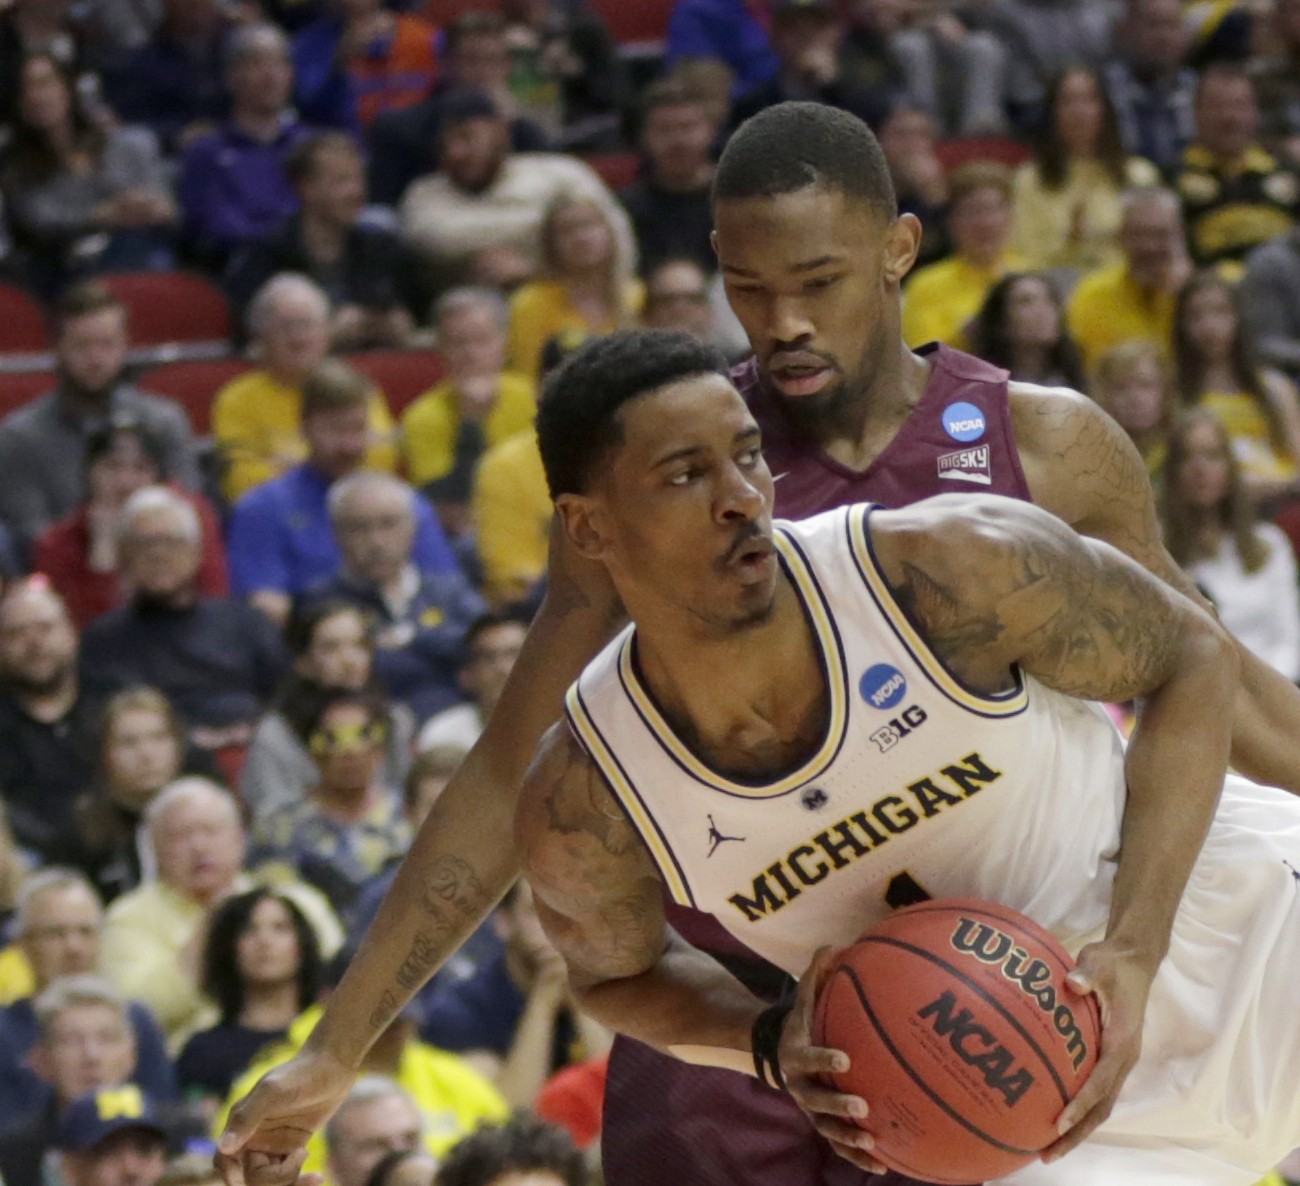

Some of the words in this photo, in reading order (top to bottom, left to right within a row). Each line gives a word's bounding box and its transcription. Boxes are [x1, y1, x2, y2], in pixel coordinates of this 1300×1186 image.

[949, 417, 985, 433] NCAA
[870, 673, 905, 706] NCAA
[725, 752, 1003, 923] MICHIGAN
[917, 991, 1036, 1108] NCAA
[951, 916, 1087, 1075] Wilson
